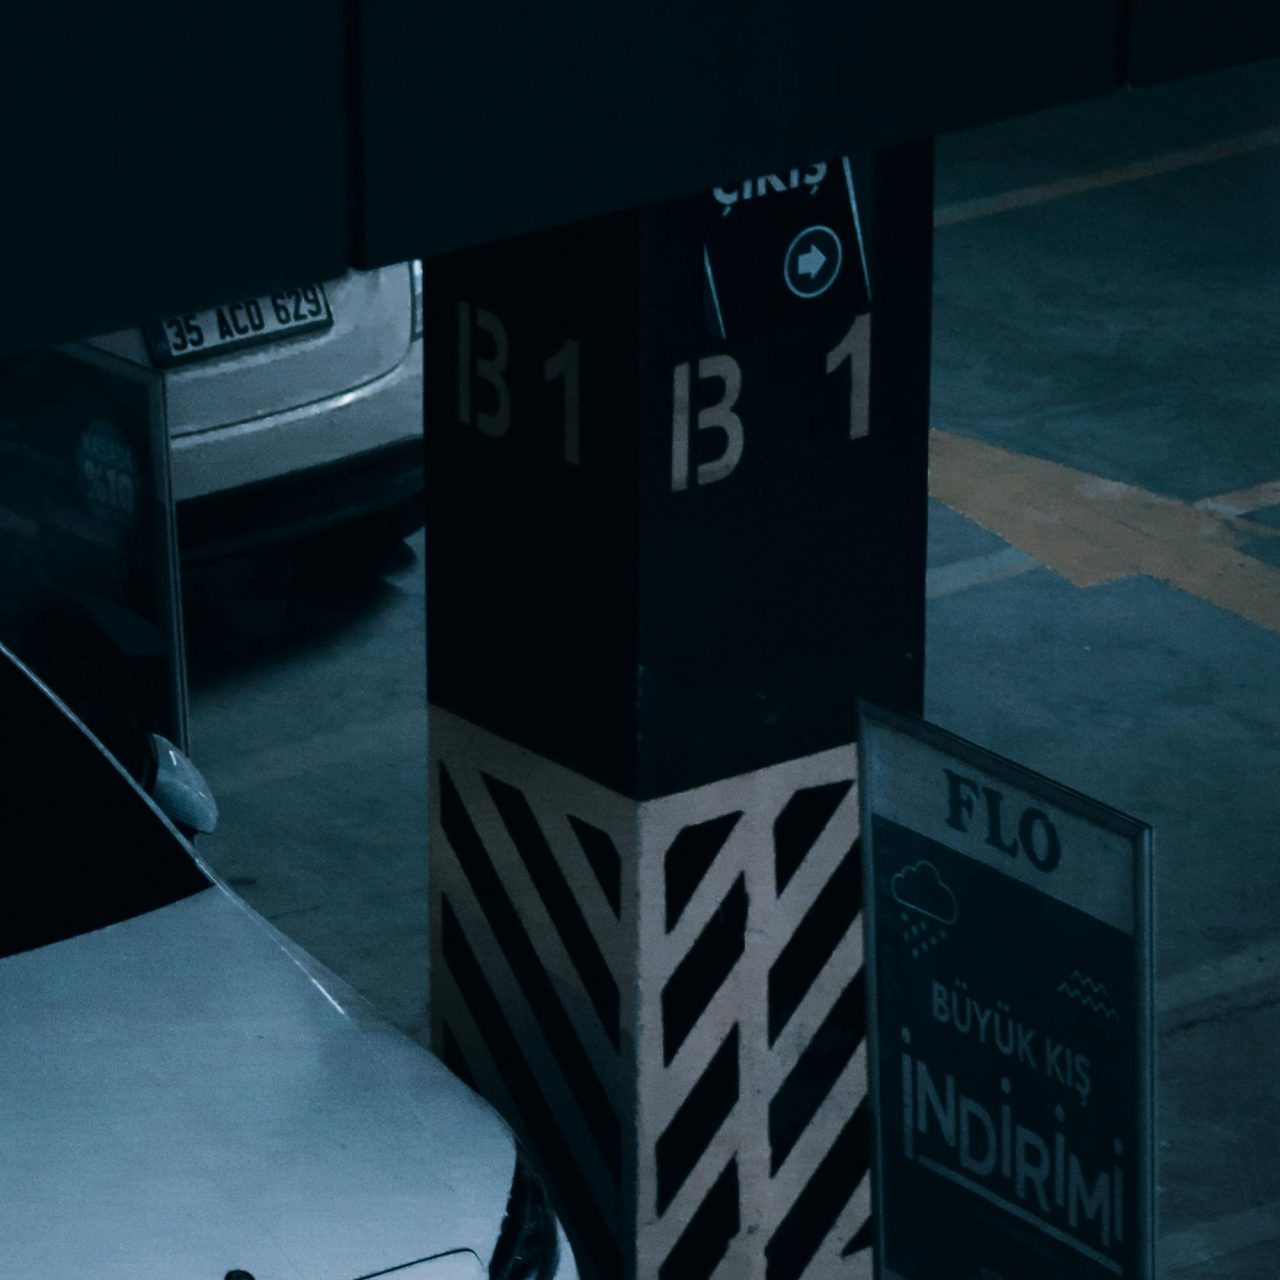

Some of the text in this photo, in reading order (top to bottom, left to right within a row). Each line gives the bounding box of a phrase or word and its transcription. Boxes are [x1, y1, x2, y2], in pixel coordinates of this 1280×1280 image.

[167, 281, 321, 350] 35 ACD 629
[458, 299, 580, 467] B 1
[671, 311, 871, 493] B 1
[944, 768, 1061, 873] FLO
[931, 977, 1091, 1108] BÜYÜK KIŞ
[900, 1026, 1124, 1248] İNDİRİMİ
